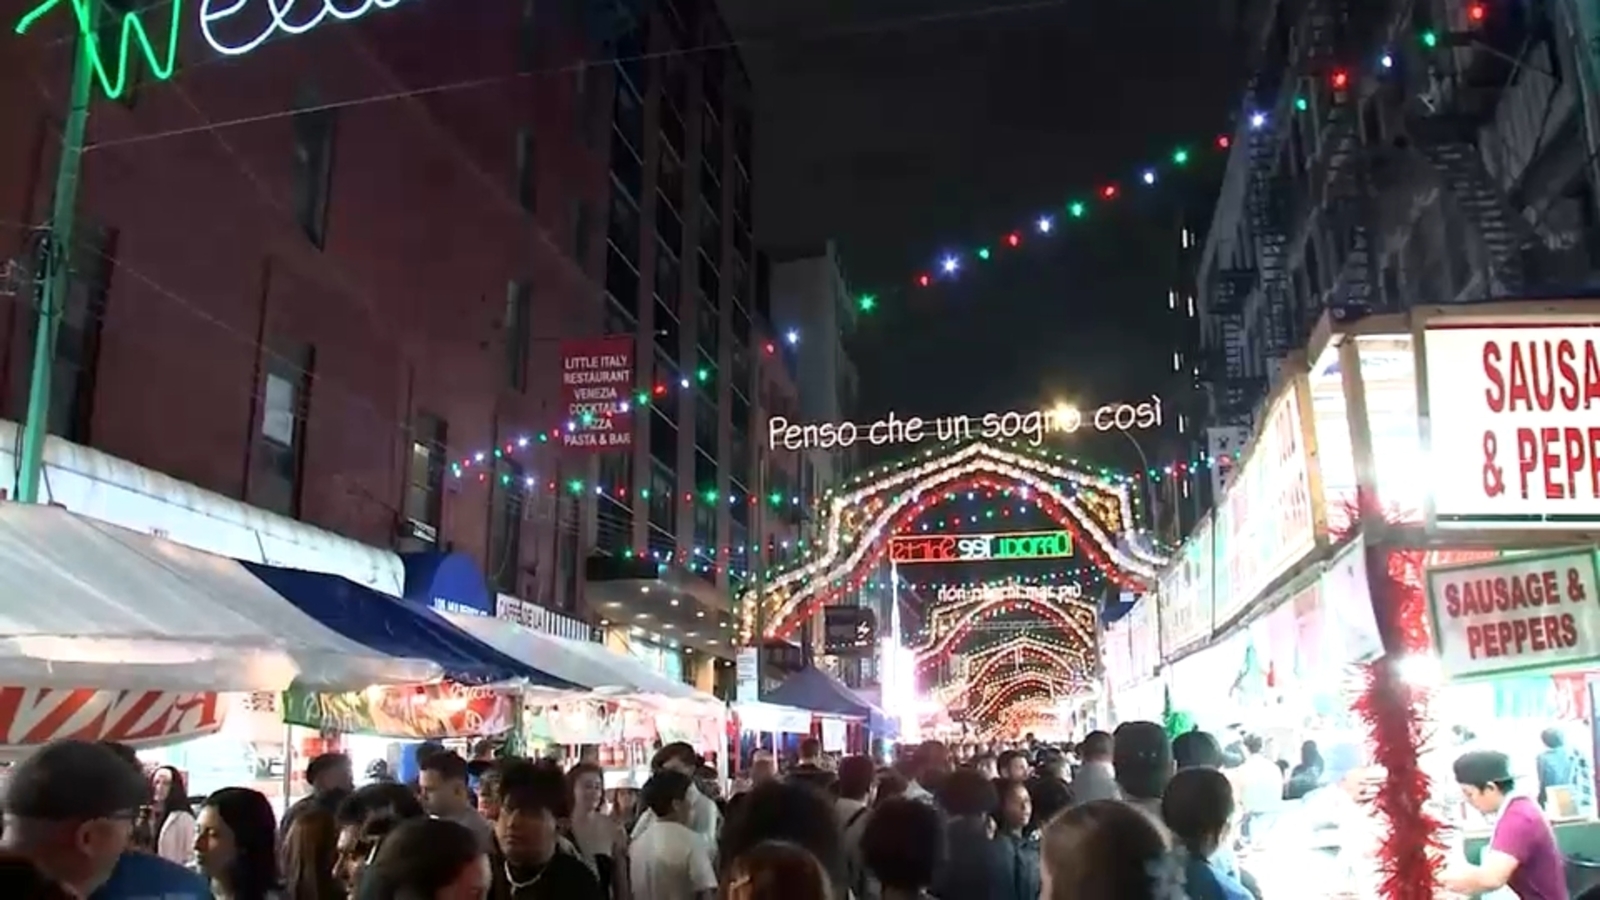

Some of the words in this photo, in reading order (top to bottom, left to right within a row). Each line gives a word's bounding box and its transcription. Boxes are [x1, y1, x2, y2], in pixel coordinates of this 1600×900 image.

[563, 370, 630, 384] RESTAURANT
[565, 357, 599, 370] LITTLE
[601, 355, 627, 368] ITALY
[573, 387, 617, 400] VENEZIA
[768, 416, 857, 451] Penso
[869, 411, 925, 445] che
[937, 414, 971, 442] un
[982, 405, 1081, 446] sogno
[1094, 394, 1162, 430] così
[564, 434, 597, 446] PASTA
[599, 434, 608, 446] &
[1483, 430, 1506, 498] &
[1444, 571, 1561, 618] SAUSAGE
[1567, 567, 1586, 603] &
[1466, 613, 1577, 660] PEPPERS
